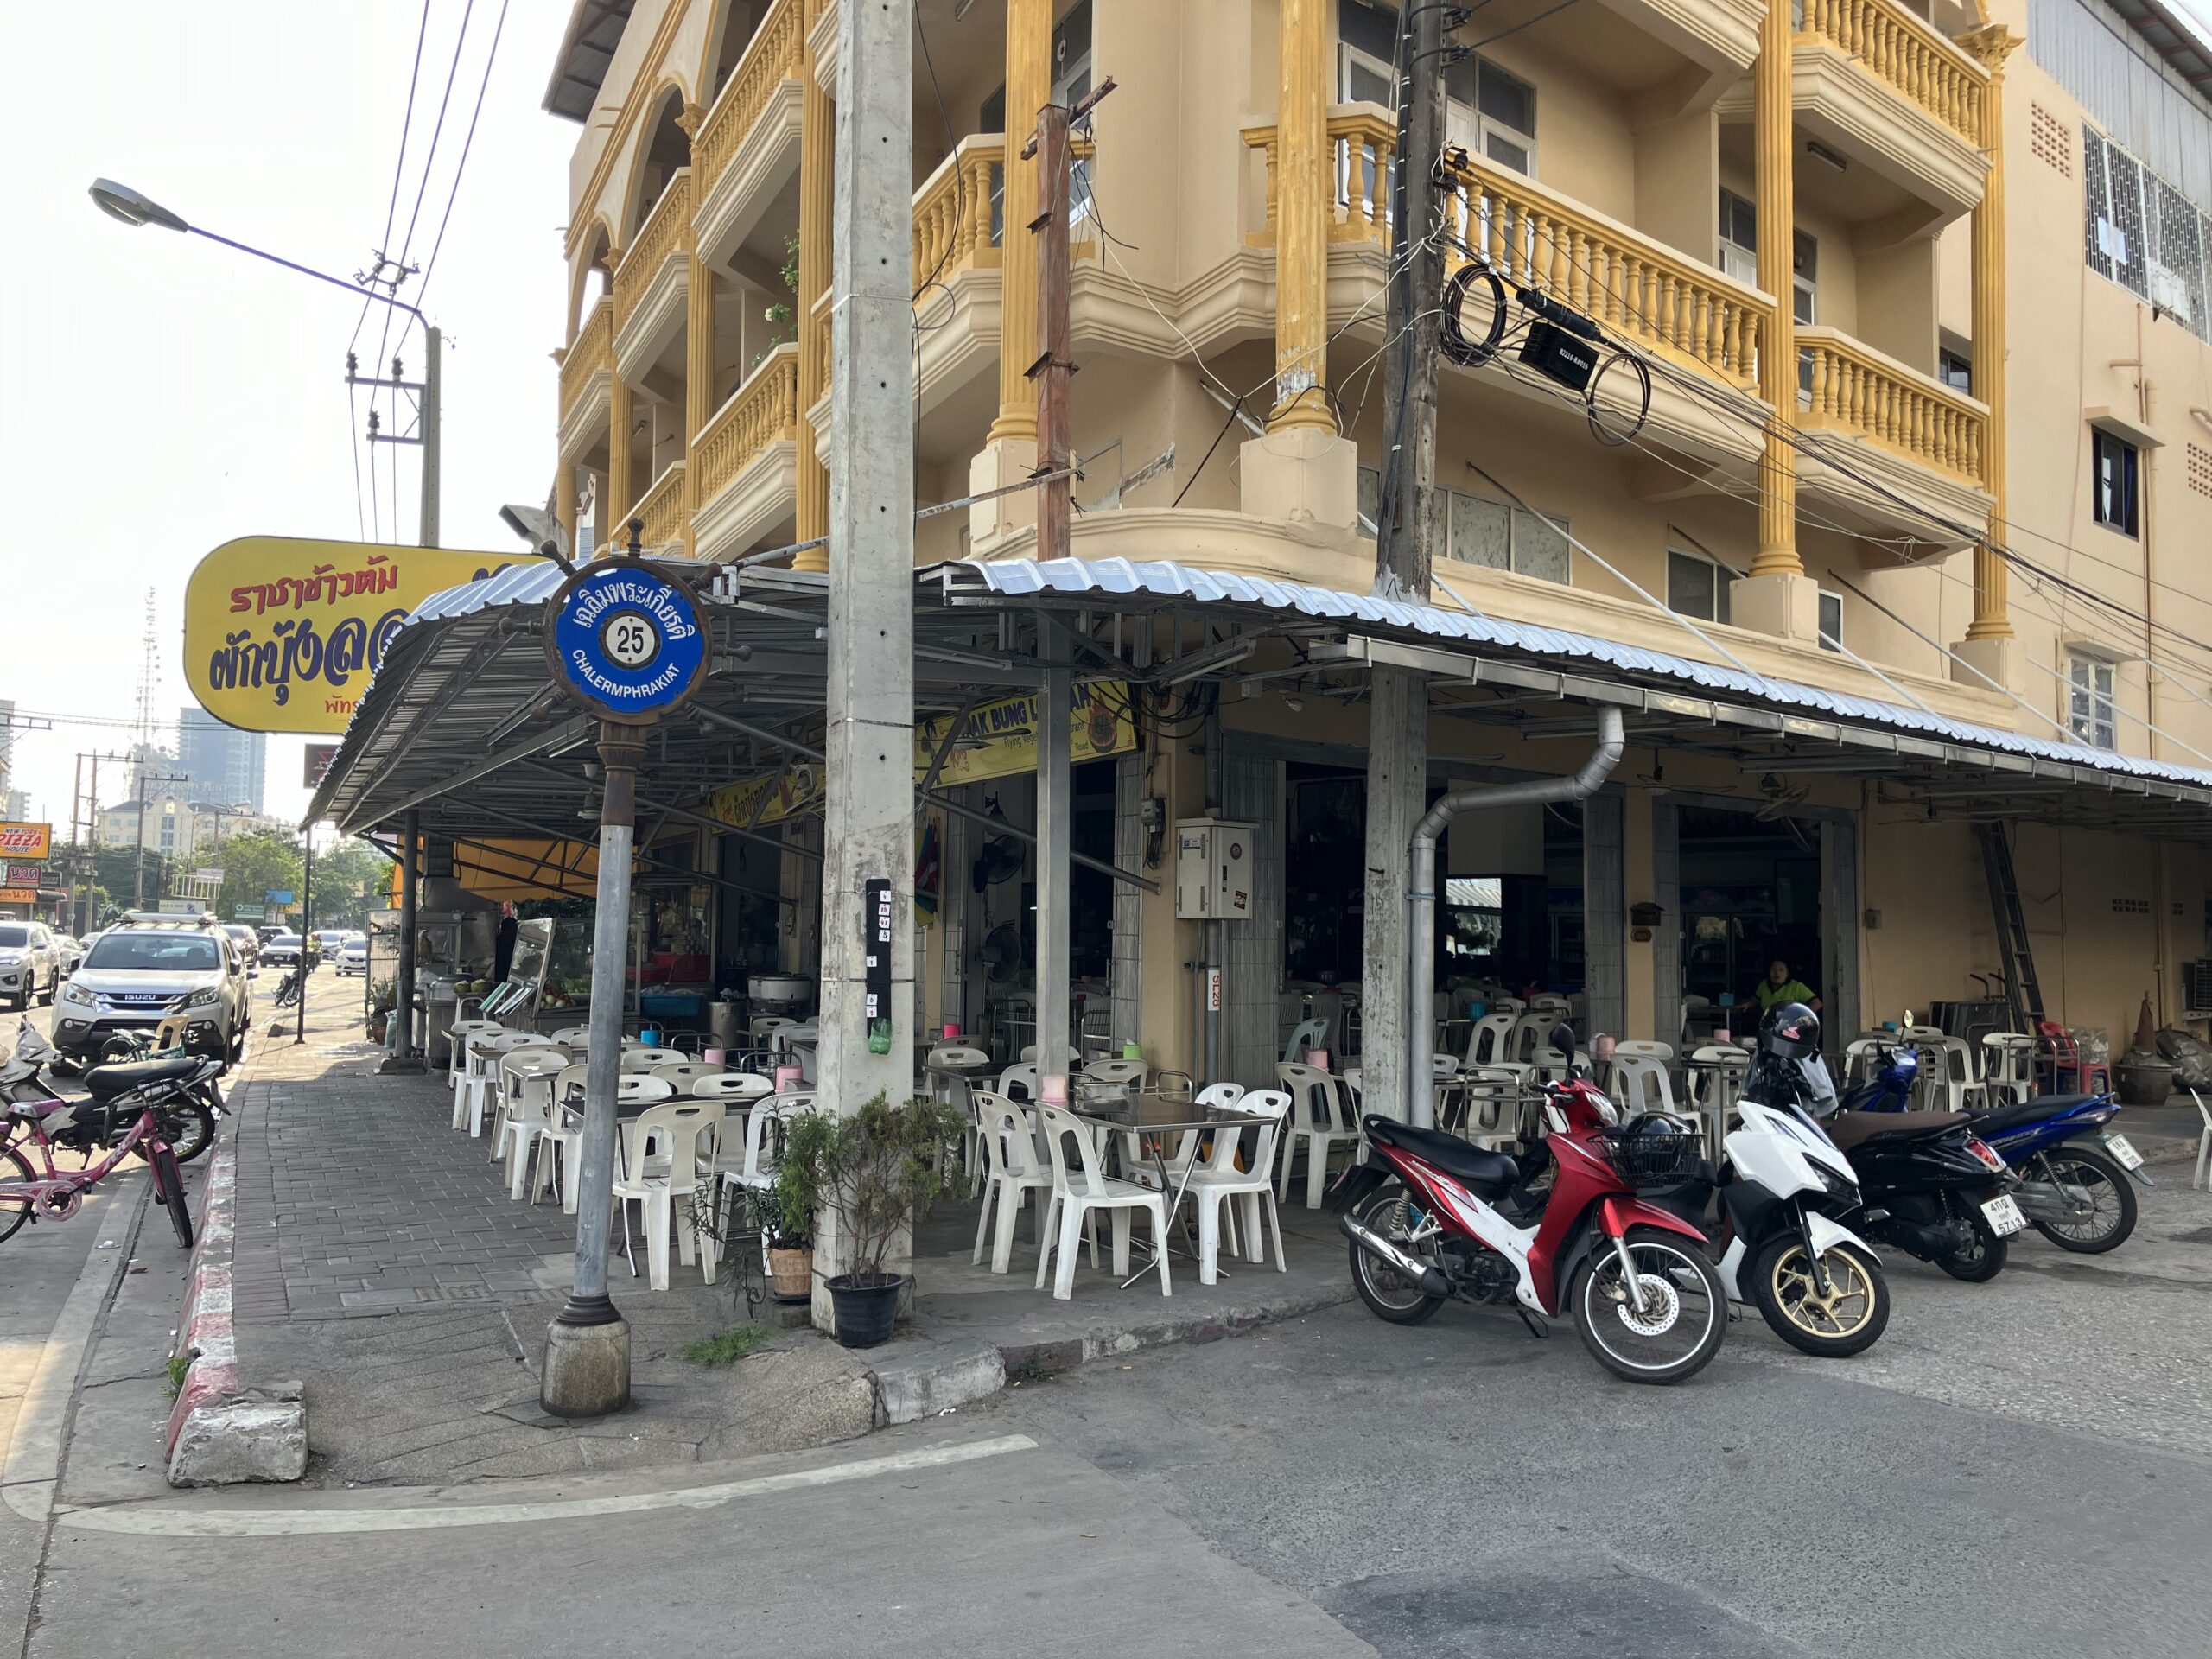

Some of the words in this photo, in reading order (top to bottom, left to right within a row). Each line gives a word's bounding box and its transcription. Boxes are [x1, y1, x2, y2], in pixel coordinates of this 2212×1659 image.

[230, 555, 399, 614] ราชาข้าวต้ม
[572, 582, 696, 640] เฉลิมพระเกียรติ
[617, 625, 644, 654] 25
[572, 649, 681, 698] CHALERMPHRAKIAT
[325, 695, 359, 714] พัท
[969, 710, 989, 735] AK
[992, 700, 1028, 734] BUNG
[1003, 735, 1023, 749] Flying
[0, 834, 42, 847] PIZZA
[10, 867, 38, 879] นวด
[13, 890, 35, 899] นวด
[1998, 1217, 2024, 1234] 5713
